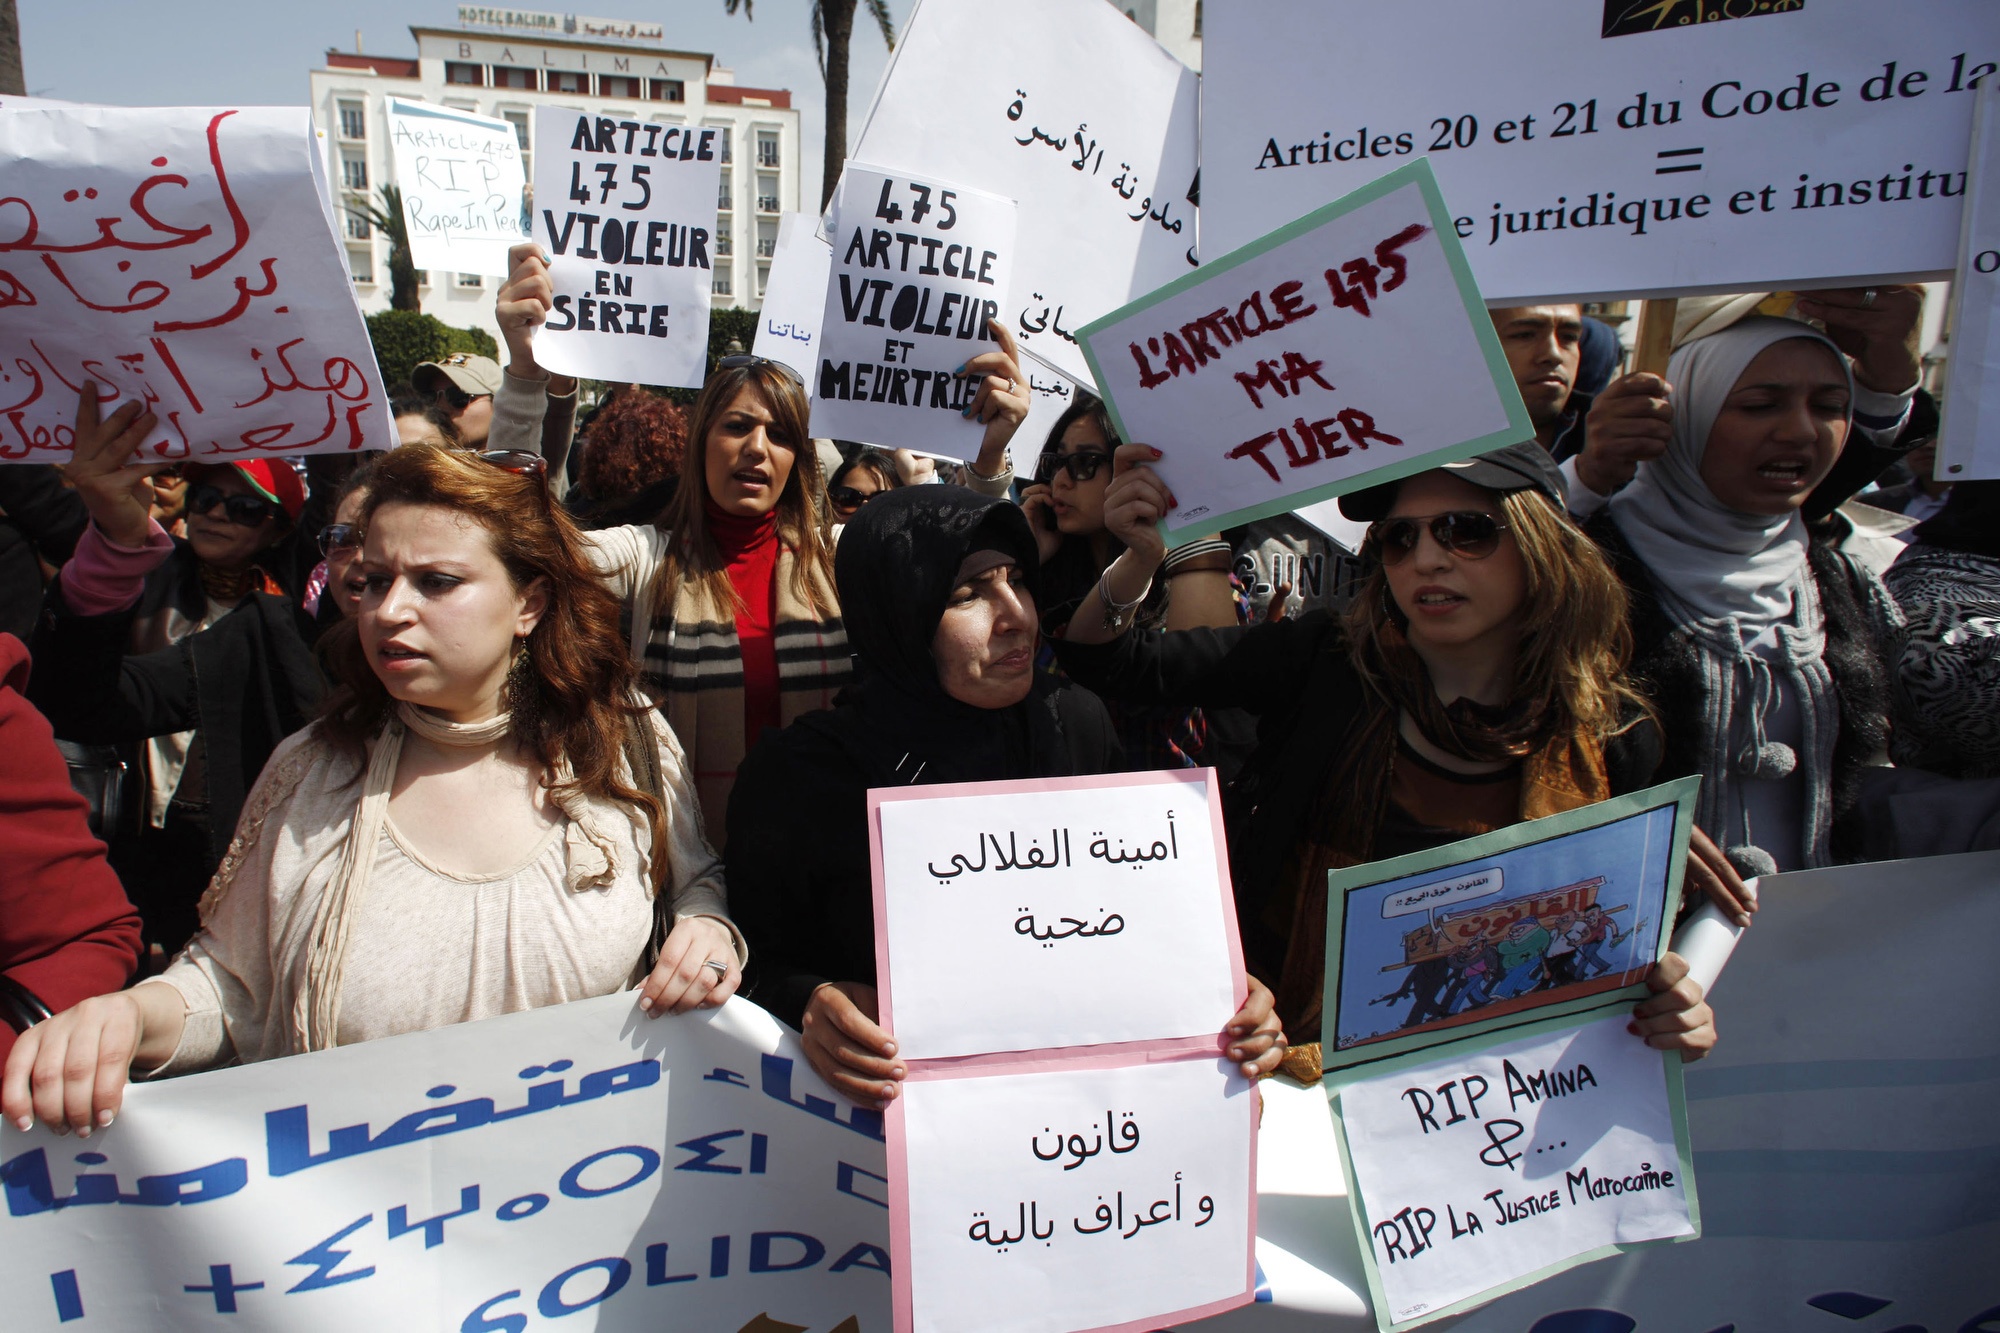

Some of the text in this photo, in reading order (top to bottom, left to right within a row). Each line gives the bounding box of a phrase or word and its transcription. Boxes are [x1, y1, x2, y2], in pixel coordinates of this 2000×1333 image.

[458, 7, 556, 29] HOTEL BALIMA
[459, 42, 669, 76] BALIMA
[570, 115, 716, 162] ARTICLE
[1007, 88, 1104, 175] الأسرة
[1255, 126, 1414, 170] Articles
[1427, 114, 1478, 152] 20
[1493, 115, 1536, 144] et
[1550, 100, 1599, 138] 21
[1616, 92, 1683, 129] du
[1701, 72, 1841, 119] Code
[1860, 61, 1929, 101] de
[482, 140, 516, 161] 475
[569, 161, 652, 211] 475
[875, 179, 957, 231] 475
[1488, 192, 1712, 245] juridique
[1728, 181, 1776, 214] et
[406, 195, 462, 247] Rape
[460, 202, 488, 232] In
[542, 209, 710, 270] VIOLEUR
[595, 270, 633, 297] EN
[843, 225, 998, 286] ARTICLE
[1324, 223, 1432, 318] 475
[545, 291, 669, 338] SÉRIE
[768, 318, 811, 346] بناتنا
[838, 273, 998, 342] VIOLEUR
[883, 338, 915, 364] ET
[1233, 351, 1336, 409] M'A
[819, 358, 987, 411] MEURTRIE
[1224, 407, 1404, 484] TUER
[927, 809, 1179, 885] أمينة الفلالي
[1014, 906, 1125, 948] ضحية
[1401, 1073, 1489, 1134] RIP
[1031, 1110, 1140, 1171] قانون
[968, 1201, 1055, 1254] بالية
[1072, 1171, 1183, 1239] أعراف
[1373, 1206, 1436, 1264] RIP
[1566, 1162, 1674, 1205] Marocaine
[460, 1231, 893, 1333] SOLIDA
